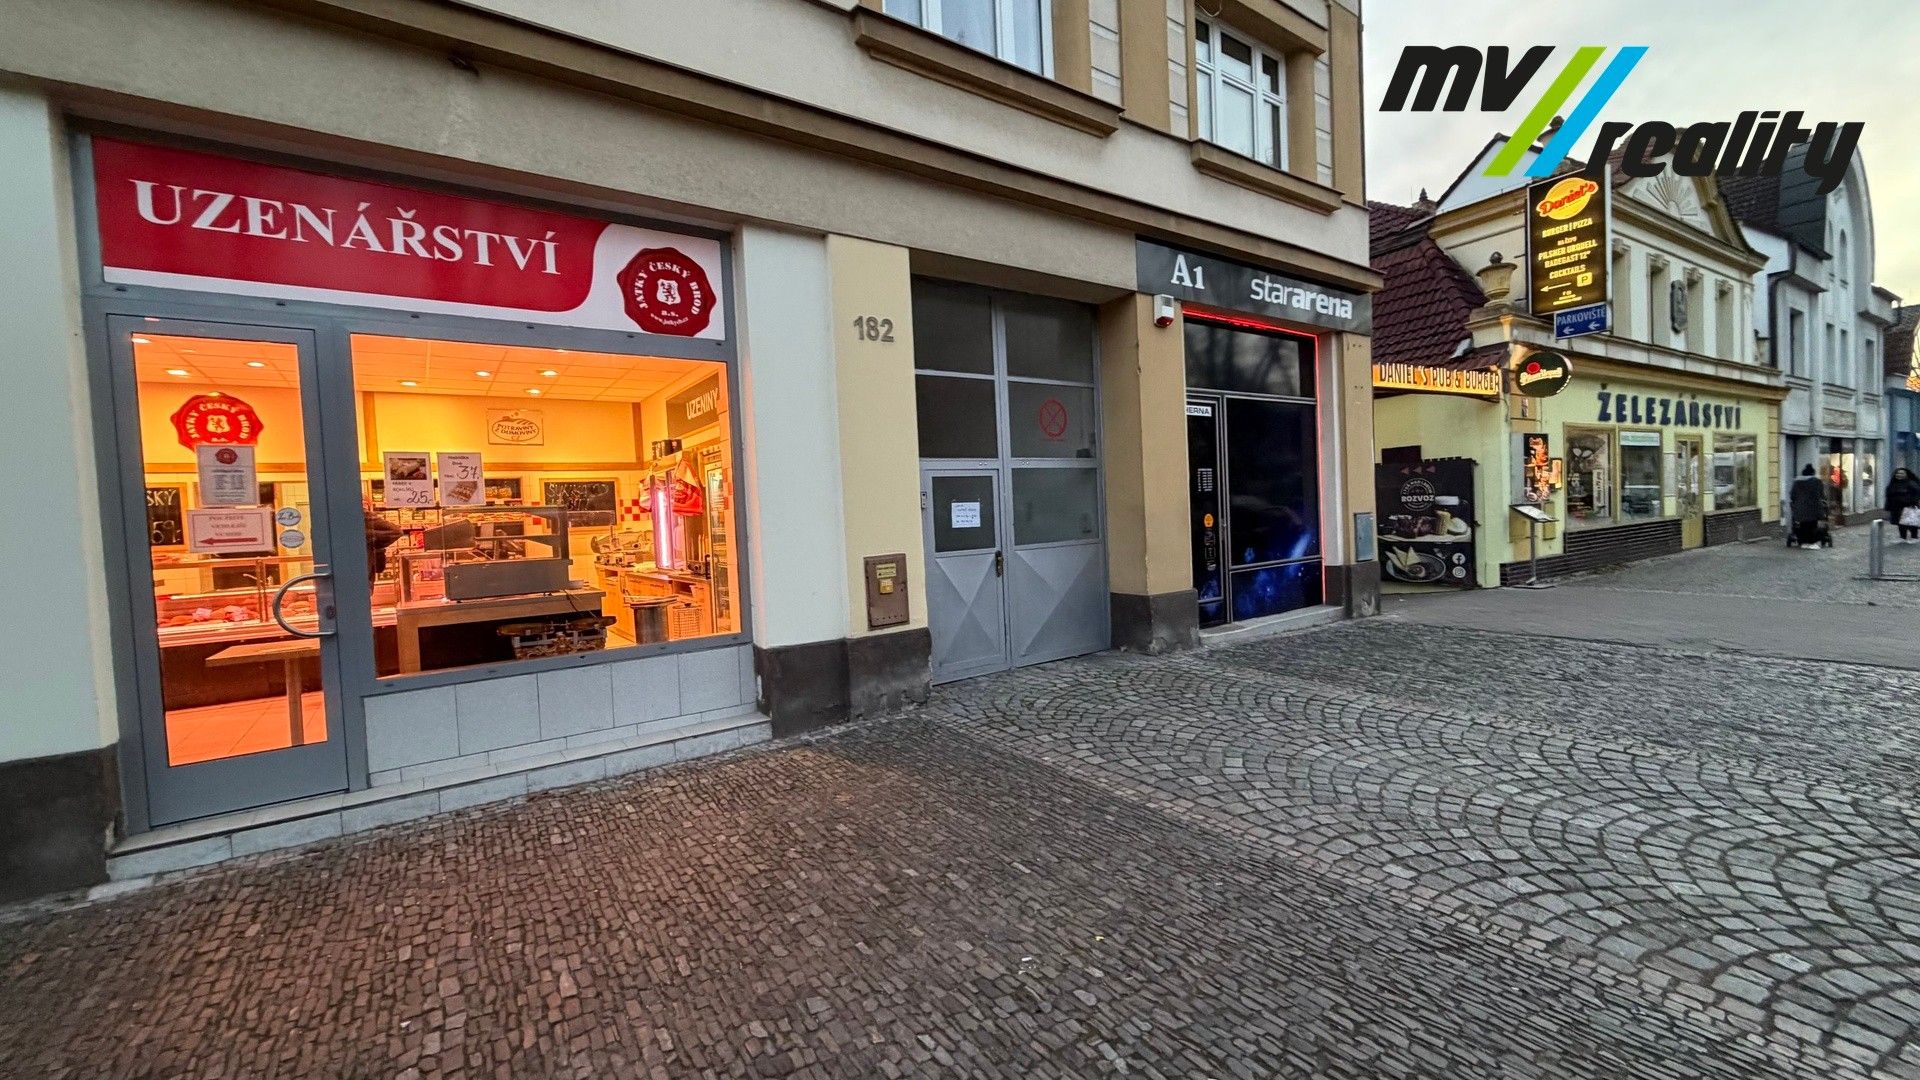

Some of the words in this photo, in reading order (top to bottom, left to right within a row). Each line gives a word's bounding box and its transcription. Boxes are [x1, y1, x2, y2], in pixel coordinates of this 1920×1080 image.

[1539, 183, 1596, 214] Daniel's
[127, 178, 562, 276] UZENÁŘSTVÍ
[1542, 223, 1569, 238] BURGER
[1573, 218, 1593, 229] PIZZA
[1538, 247, 1566, 261] PILSNER
[1566, 239, 1598, 253] URQUELL
[1544, 253, 1579, 268] RADEGAST
[1170, 253, 1205, 290] A1
[1549, 264, 1586, 279] COCKTAILS
[634, 270, 648, 309] JATKY
[648, 261, 691, 278] ČESKÝ
[689, 281, 702, 315] BROD
[1250, 275, 1353, 320] stararena
[853, 315, 895, 343] 182
[1556, 307, 1606, 325] PARKOVIŠTĚ
[1429, 367, 1452, 388] PUB
[1454, 369, 1462, 388] &
[1463, 370, 1499, 393] BURGER
[686, 387, 719, 420] UZENINY
[1598, 383, 1742, 430] ŽELEZÁŘSTVÍ
[1401, 494, 1435, 503] ROZVOZ
